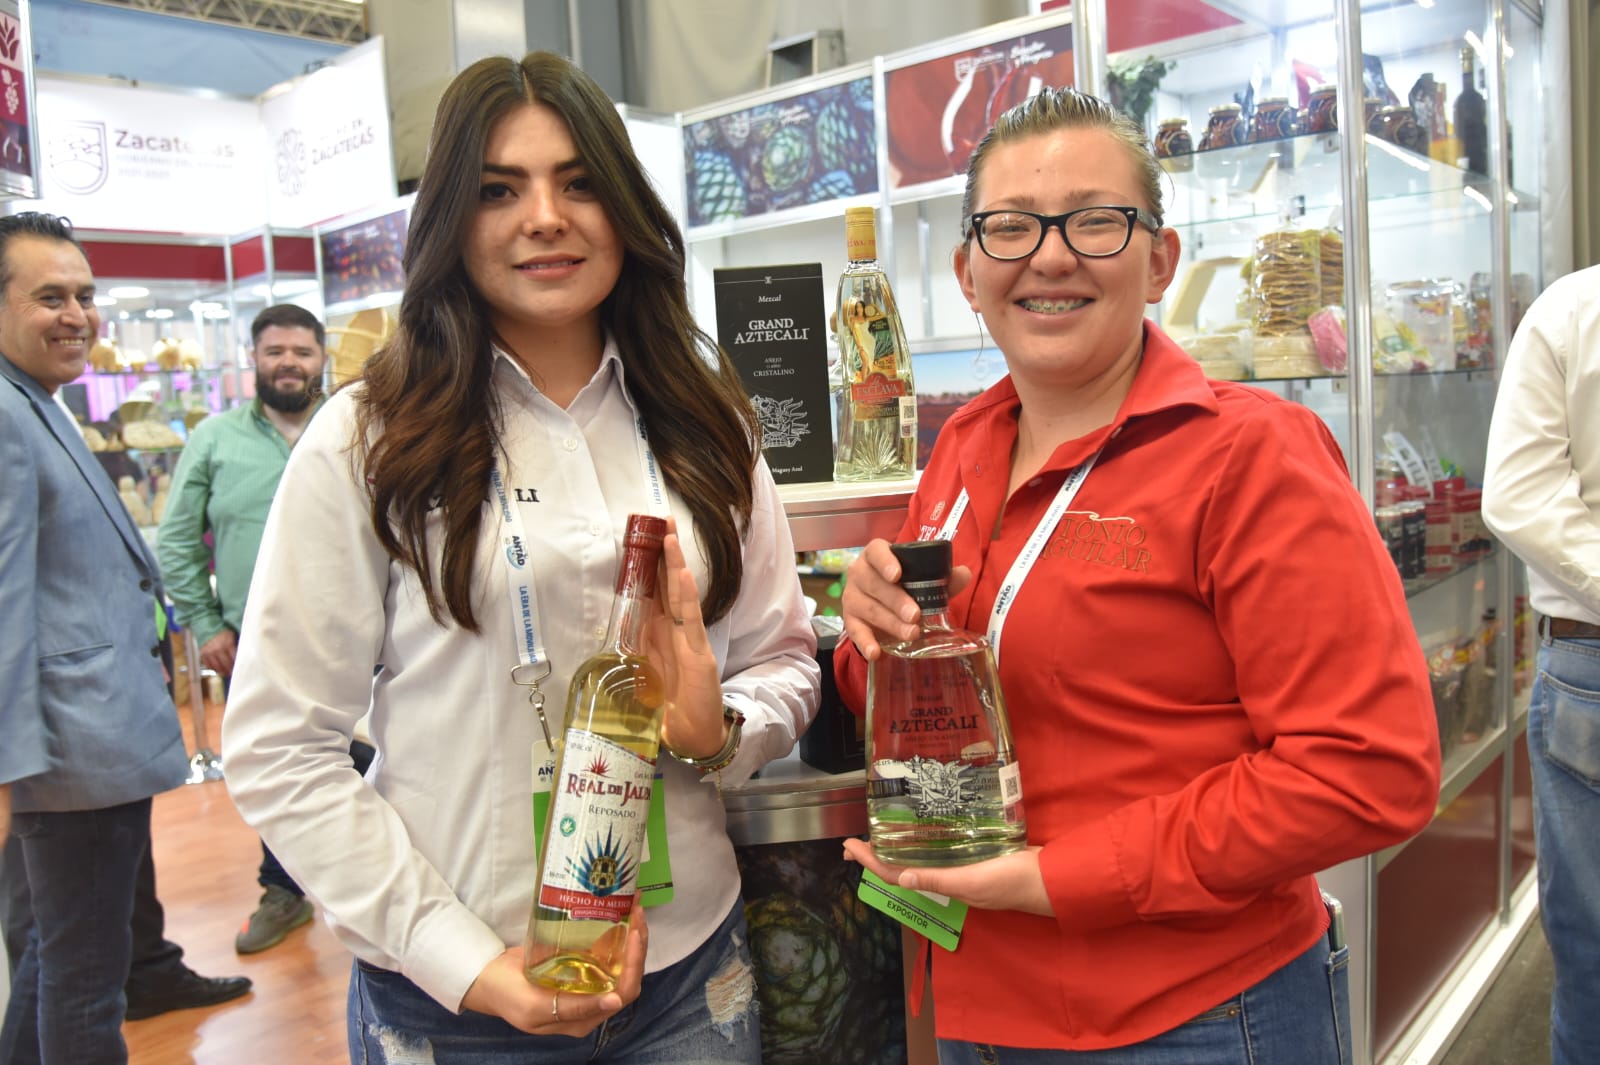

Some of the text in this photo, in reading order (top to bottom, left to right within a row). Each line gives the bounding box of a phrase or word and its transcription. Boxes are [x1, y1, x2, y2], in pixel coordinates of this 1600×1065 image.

[114, 128, 235, 158] Zacateas
[758, 294, 782, 303] Mezcal
[748, 318, 794, 331] GRAND
[734, 328, 810, 345] AZTECALI
[753, 368, 795, 377] CRISTALINO
[910, 705, 953, 717] GRAND
[889, 714, 979, 733] AZTECALI
[566, 773, 606, 798] REAL
[607, 783, 624, 795] DE
[588, 803, 636, 819] REPOSADO
[559, 894, 591, 906] HECHO
[592, 897, 607, 906] EN
[887, 900, 928, 929] EXPOSITOR
